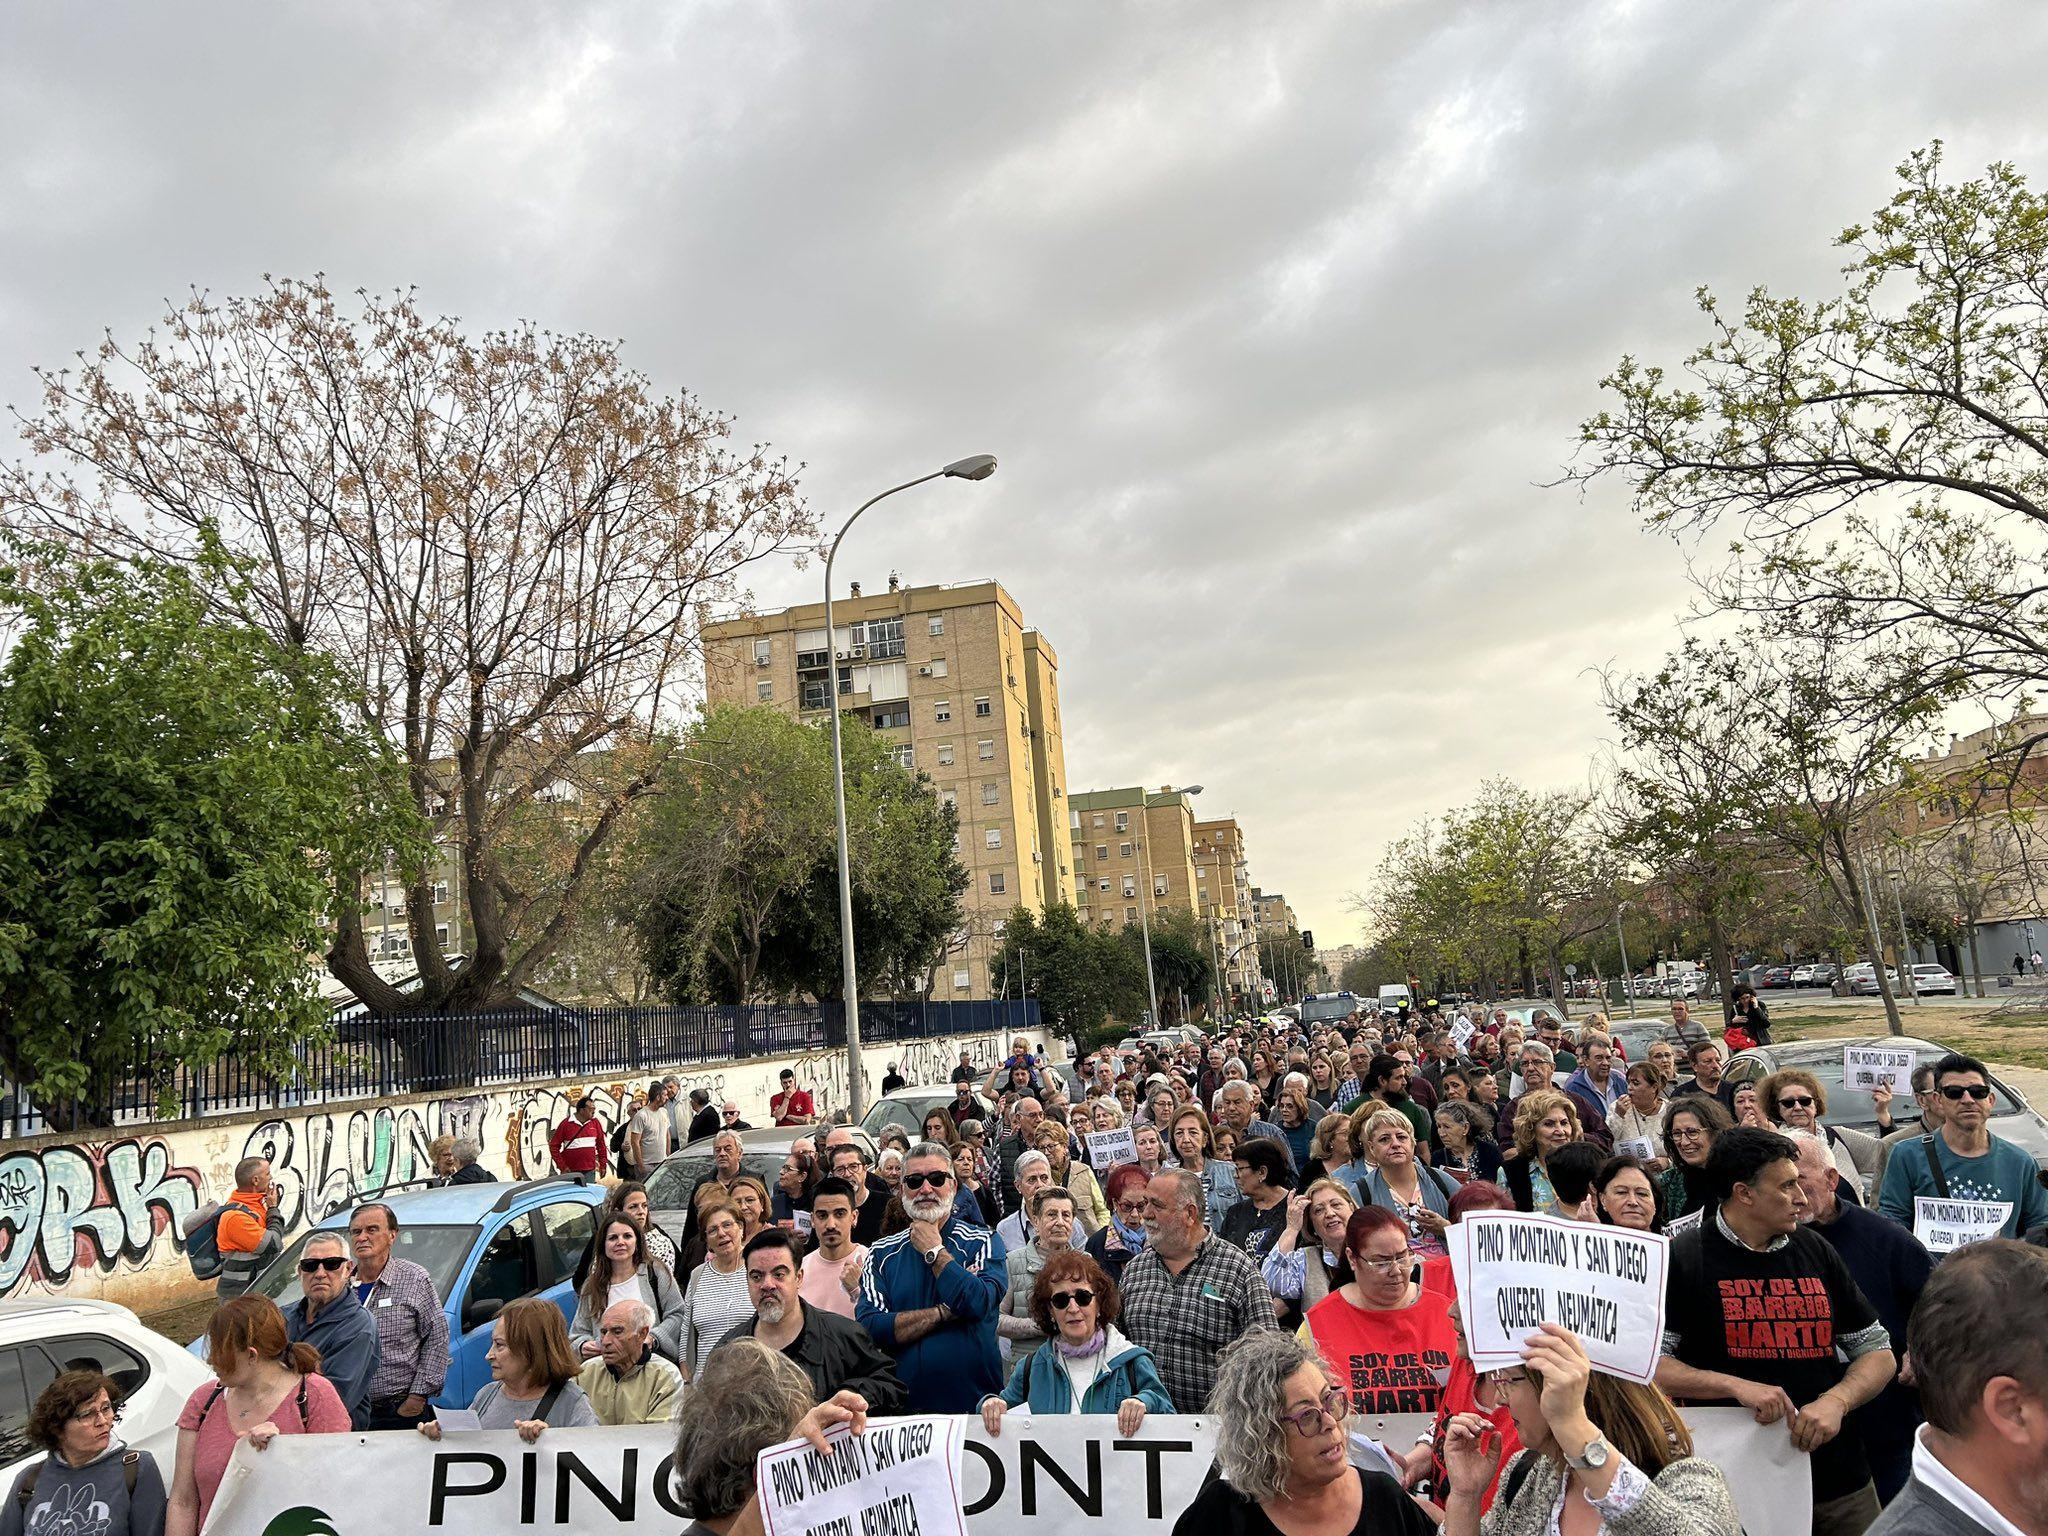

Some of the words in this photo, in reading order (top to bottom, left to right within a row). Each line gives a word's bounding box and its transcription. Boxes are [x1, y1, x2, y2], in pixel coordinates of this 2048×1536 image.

[1922, 1202, 1936, 1221] PINO
[1937, 1203, 1965, 1223] MONTANO
[1967, 1206, 1971, 1223] Y
[1973, 1206, 1985, 1224] SAN
[1986, 1207, 2002, 1224] DIEGO
[1929, 1229, 1954, 1245] QUIEREN
[1477, 1224, 1503, 1263] PINO
[1509, 1224, 1567, 1268] MONTANO
[1571, 1234, 1579, 1270] Y
[1585, 1235, 1610, 1275] SAN
[1614, 1239, 1648, 1285] DIEGO
[1717, 1279, 1764, 1297] SOY
[1769, 1278, 1797, 1296] DE
[1797, 1277, 1826, 1295] UN
[1497, 1287, 1545, 1341] QUIEREN
[1557, 1285, 1618, 1344] NEUMÁTICA
[1721, 1295, 1832, 1320] BARRIO
[1725, 1320, 1832, 1348] HARTO
[1349, 1352, 1389, 1369] SOY
[1393, 1353, 1419, 1368] DE
[1422, 1350, 1451, 1366] UN
[1779, 1347, 1785, 1359] Y
[1351, 1366, 1446, 1390] BARRI
[1352, 1386, 1447, 1414] HART
[771, 1458, 804, 1507] PINO
[804, 1436, 861, 1496] MONTANO
[858, 1434, 871, 1475] Y
[871, 1428, 895, 1472] SAN
[899, 1423, 933, 1462] DIEGO
